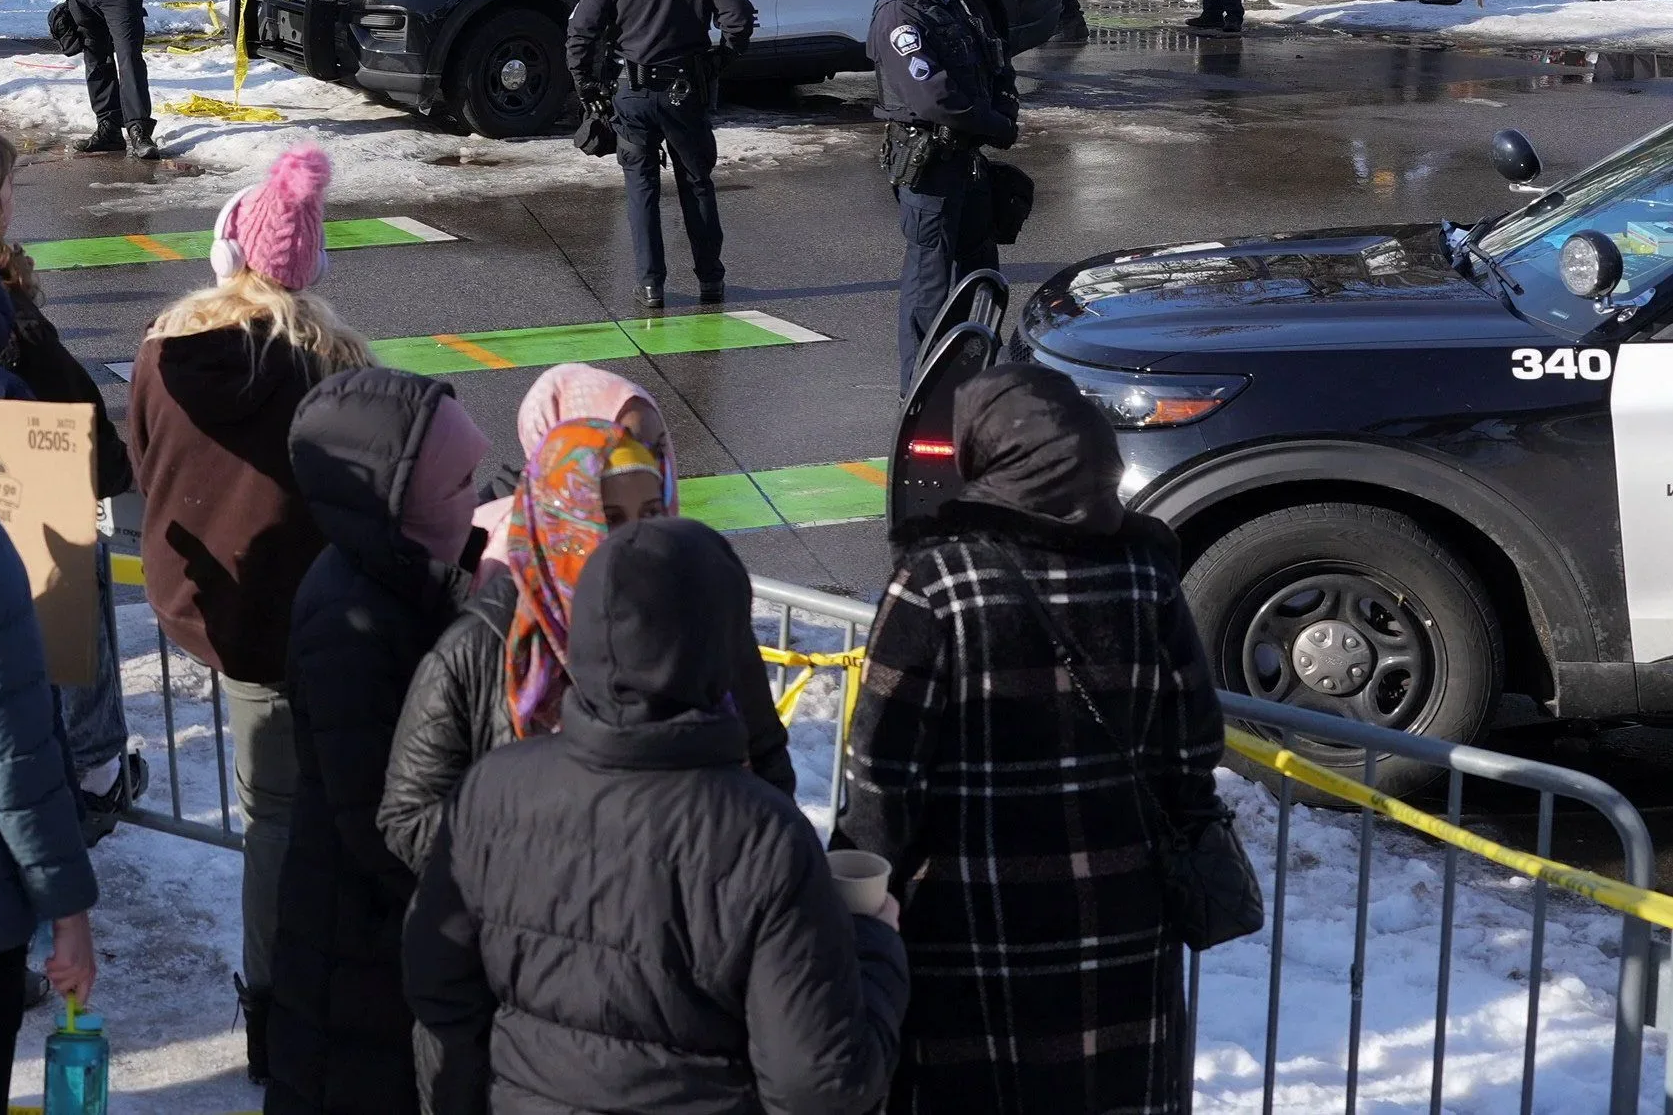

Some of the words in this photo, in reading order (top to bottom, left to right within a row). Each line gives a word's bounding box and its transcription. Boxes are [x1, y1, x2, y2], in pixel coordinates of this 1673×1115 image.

[1511, 348, 1612, 381] 340
[28, 429, 70, 452] 02505
[3, 484, 17, 497] go
